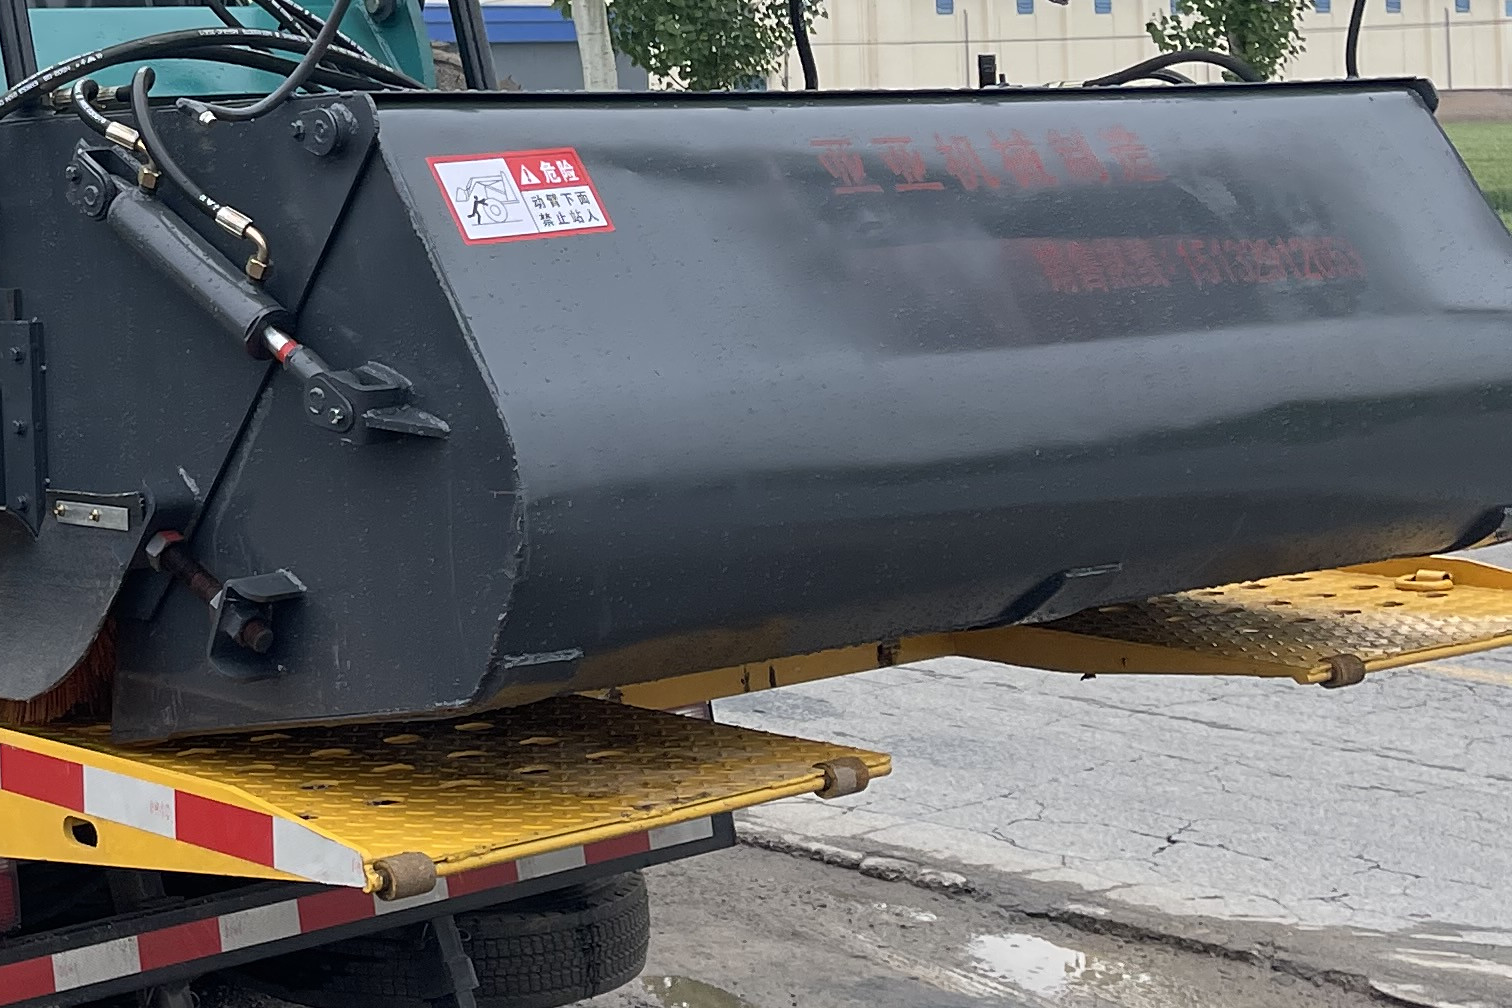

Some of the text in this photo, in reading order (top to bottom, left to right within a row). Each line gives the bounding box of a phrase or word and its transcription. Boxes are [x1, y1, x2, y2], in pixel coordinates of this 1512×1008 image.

[539, 159, 580, 184] 危险
[531, 190, 591, 210] 动臂下面
[539, 208, 600, 228] 禁止站人
